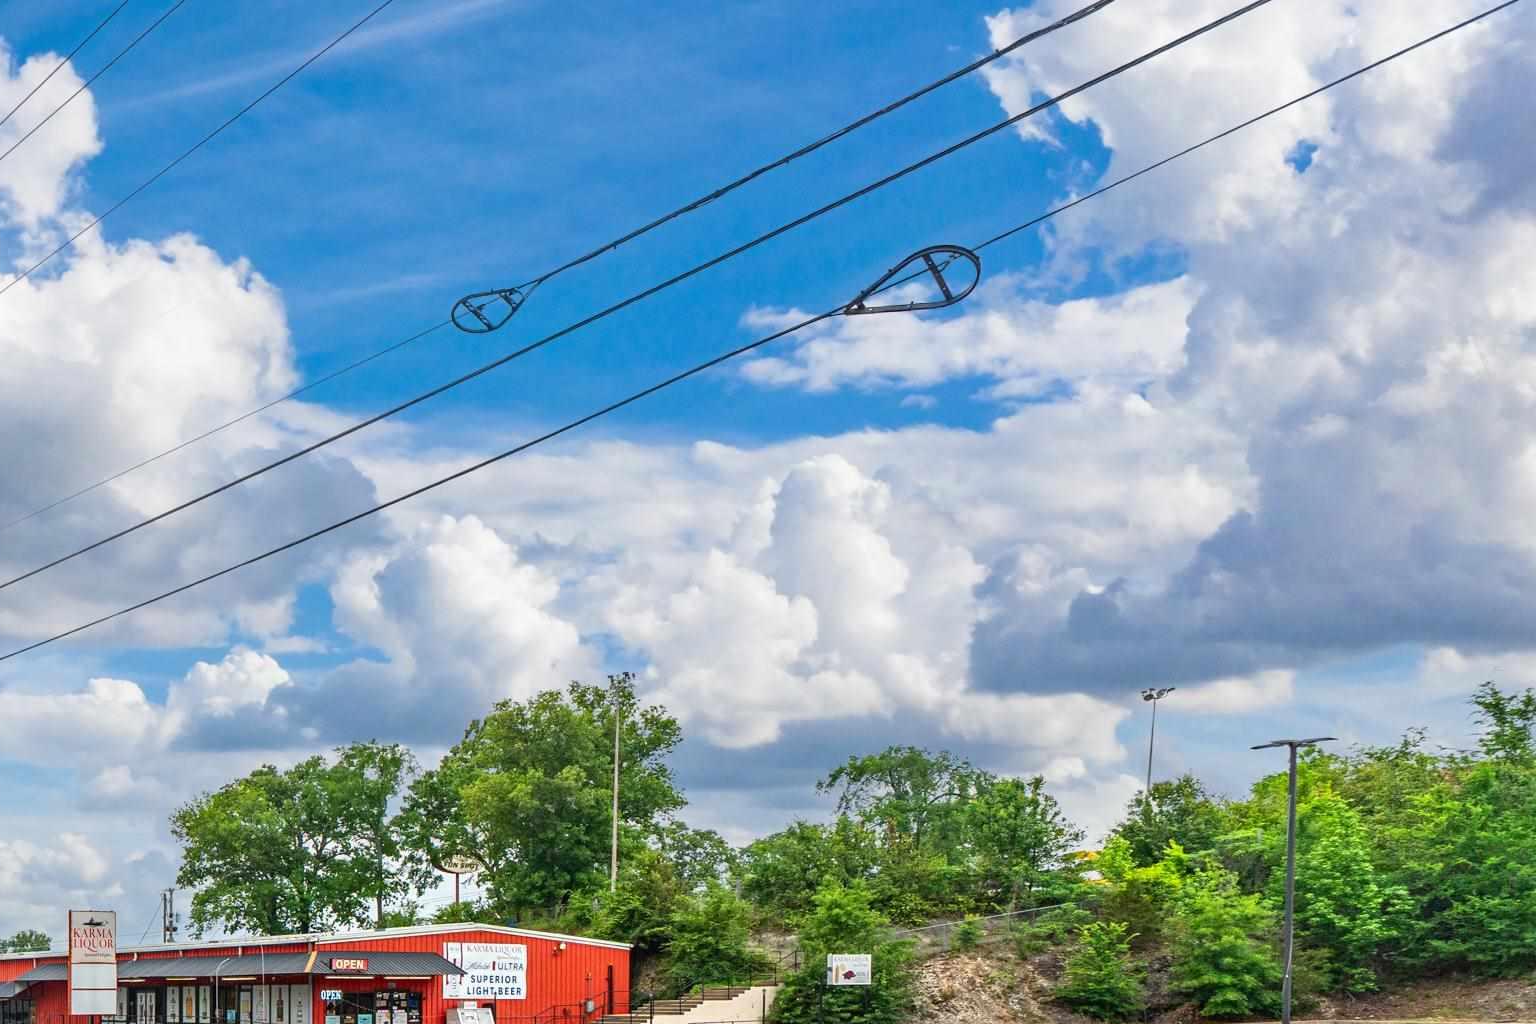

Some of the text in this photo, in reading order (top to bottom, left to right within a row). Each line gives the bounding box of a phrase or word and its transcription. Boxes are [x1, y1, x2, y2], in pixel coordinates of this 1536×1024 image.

[73, 927, 113, 938] KARMA
[73, 939, 114, 952] LIQUOR
[335, 959, 364, 969] OPEN
[497, 962, 524, 971] ULTRA
[470, 975, 517, 984] SUPERIOR
[321, 990, 342, 1000] OPEN
[466, 986, 522, 996] LIGHT BEER
